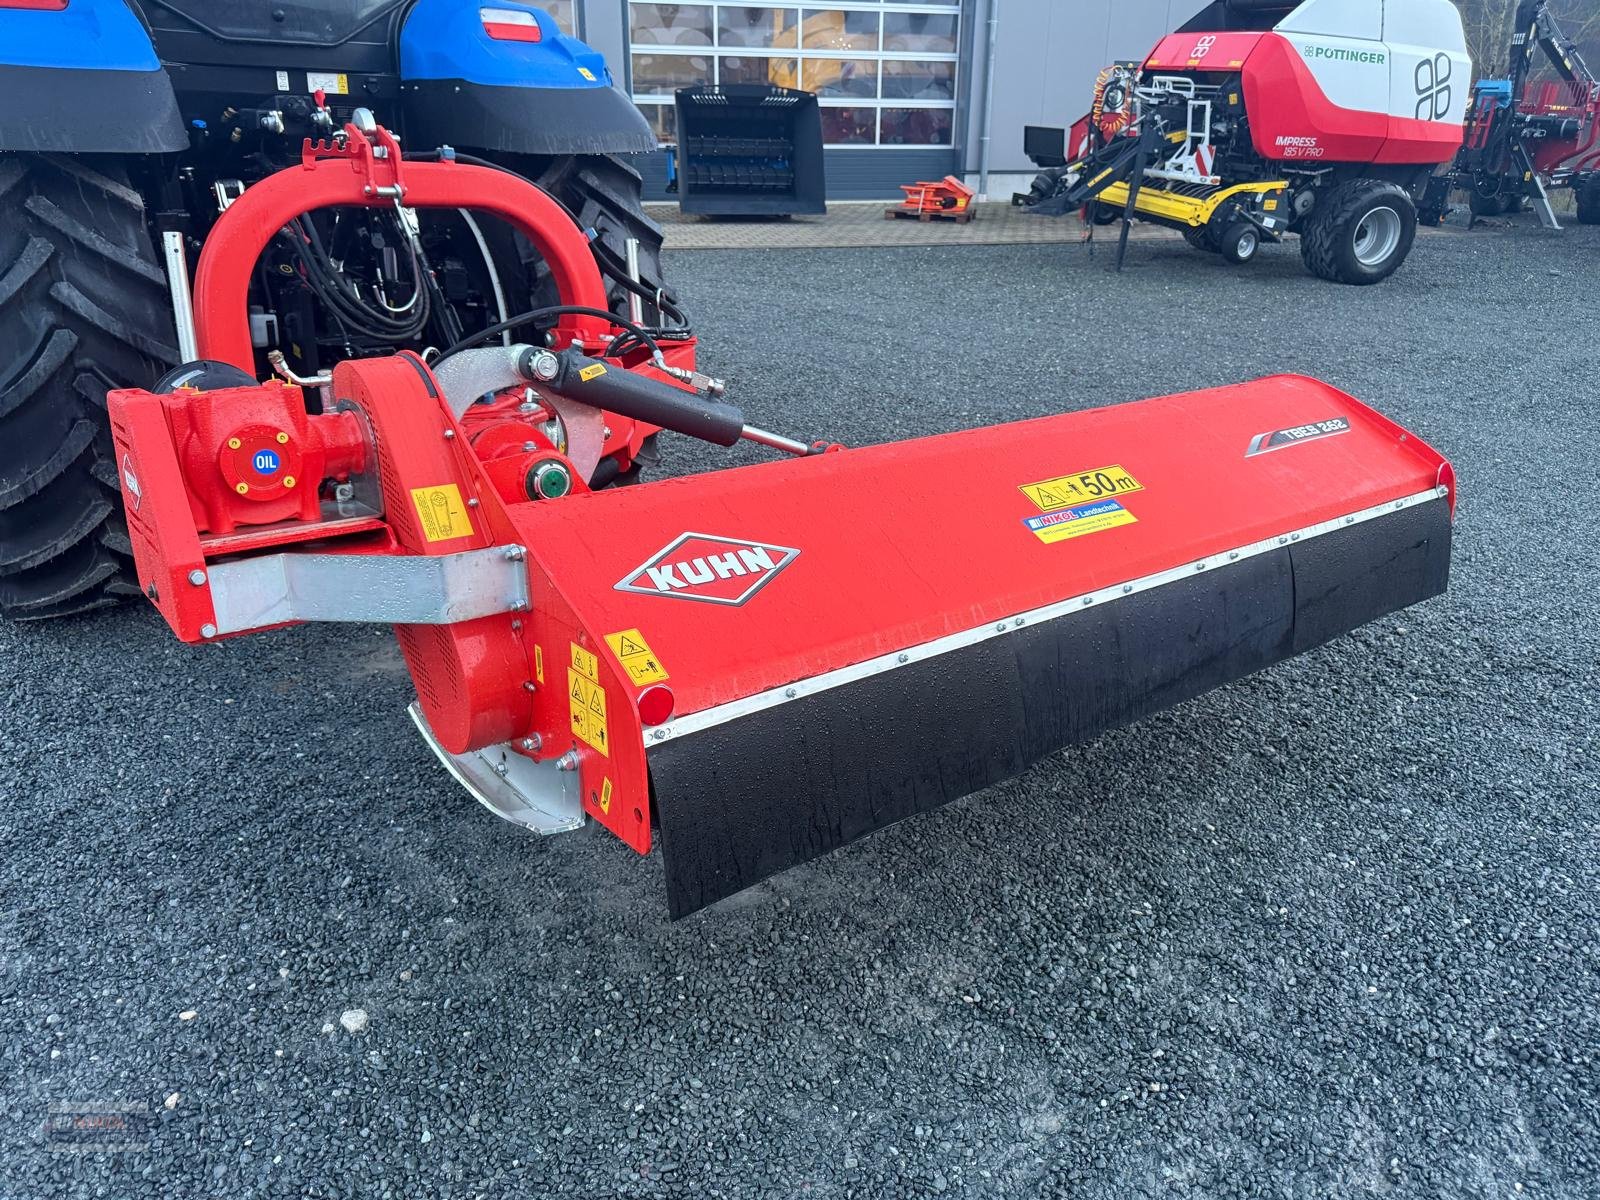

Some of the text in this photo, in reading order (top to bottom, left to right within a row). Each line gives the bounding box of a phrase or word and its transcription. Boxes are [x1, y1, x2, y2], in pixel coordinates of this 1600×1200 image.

[1275, 135, 1317, 147] IMPRESS
[1283, 147, 1324, 157] 185 V PRO
[1279, 419, 1348, 440] TBES 262
[256, 455, 277, 470] OIL
[1079, 472, 1136, 496] 50 m
[1040, 510, 1078, 526] NIKOL
[1079, 502, 1120, 517] Landtechnik
[645, 546, 777, 592] KUHN
